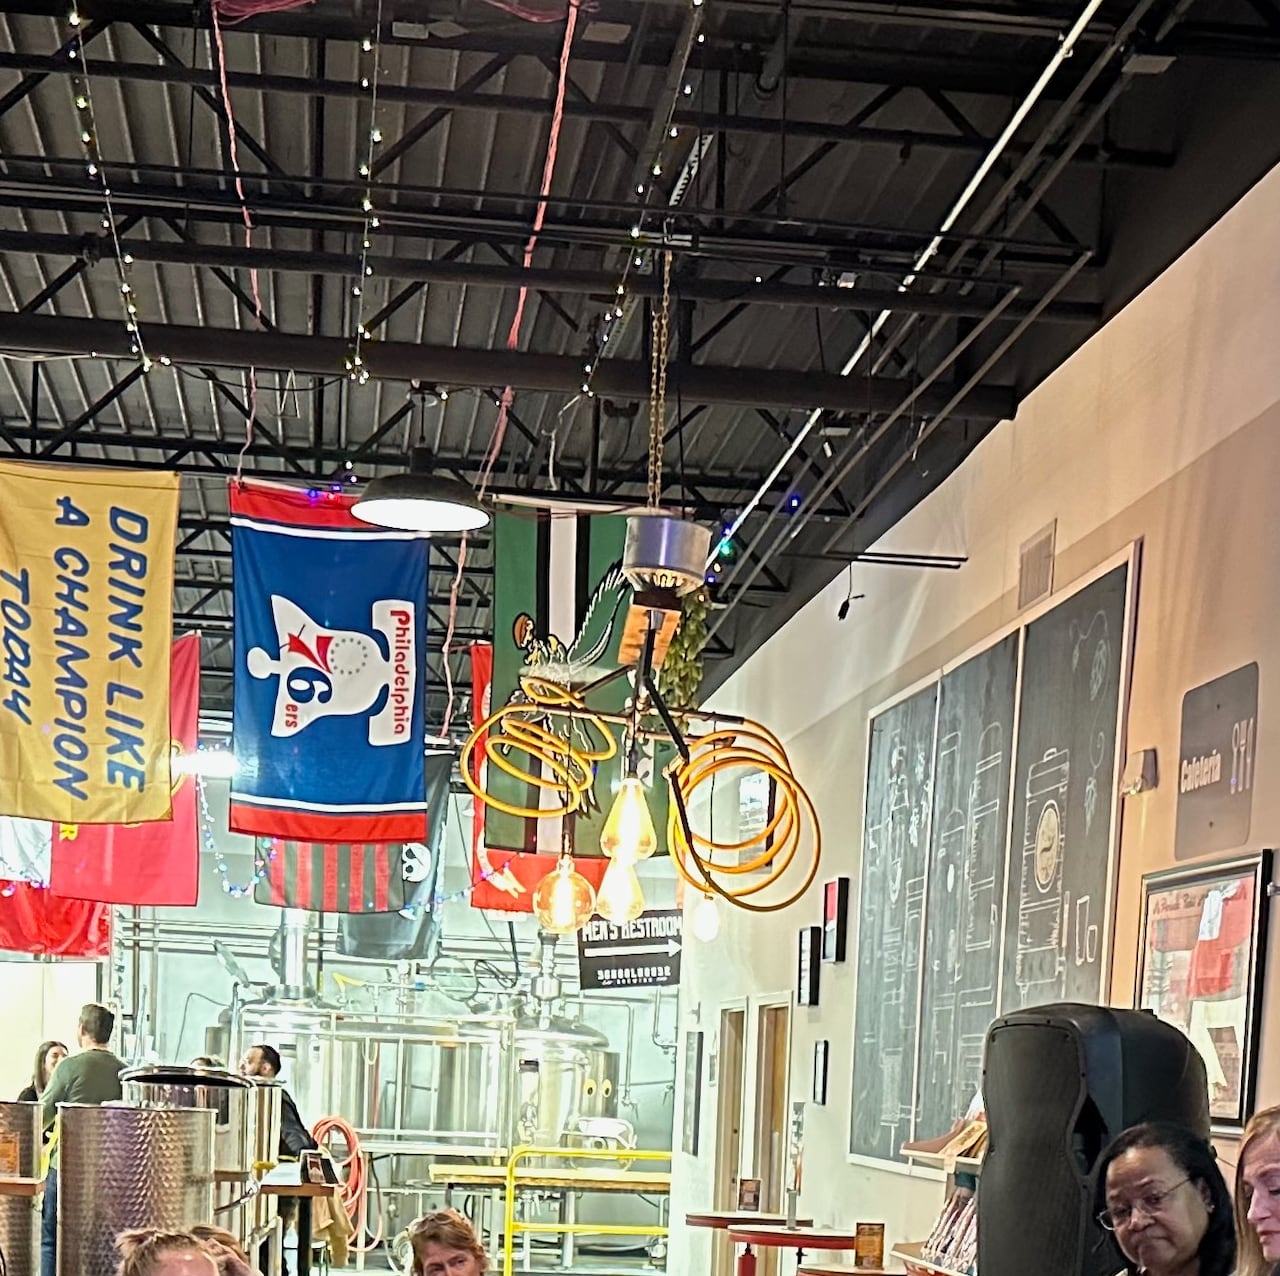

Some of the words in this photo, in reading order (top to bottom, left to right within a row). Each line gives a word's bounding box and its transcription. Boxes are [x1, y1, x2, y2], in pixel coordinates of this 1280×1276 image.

[55, 496, 90, 526] A
[0, 567, 33, 726] TODAY
[108, 506, 149, 668] DRINK
[53, 546, 90, 801] CHAMPION
[105, 681, 146, 793] LIKE
[390, 610, 411, 735] Philadelphia
